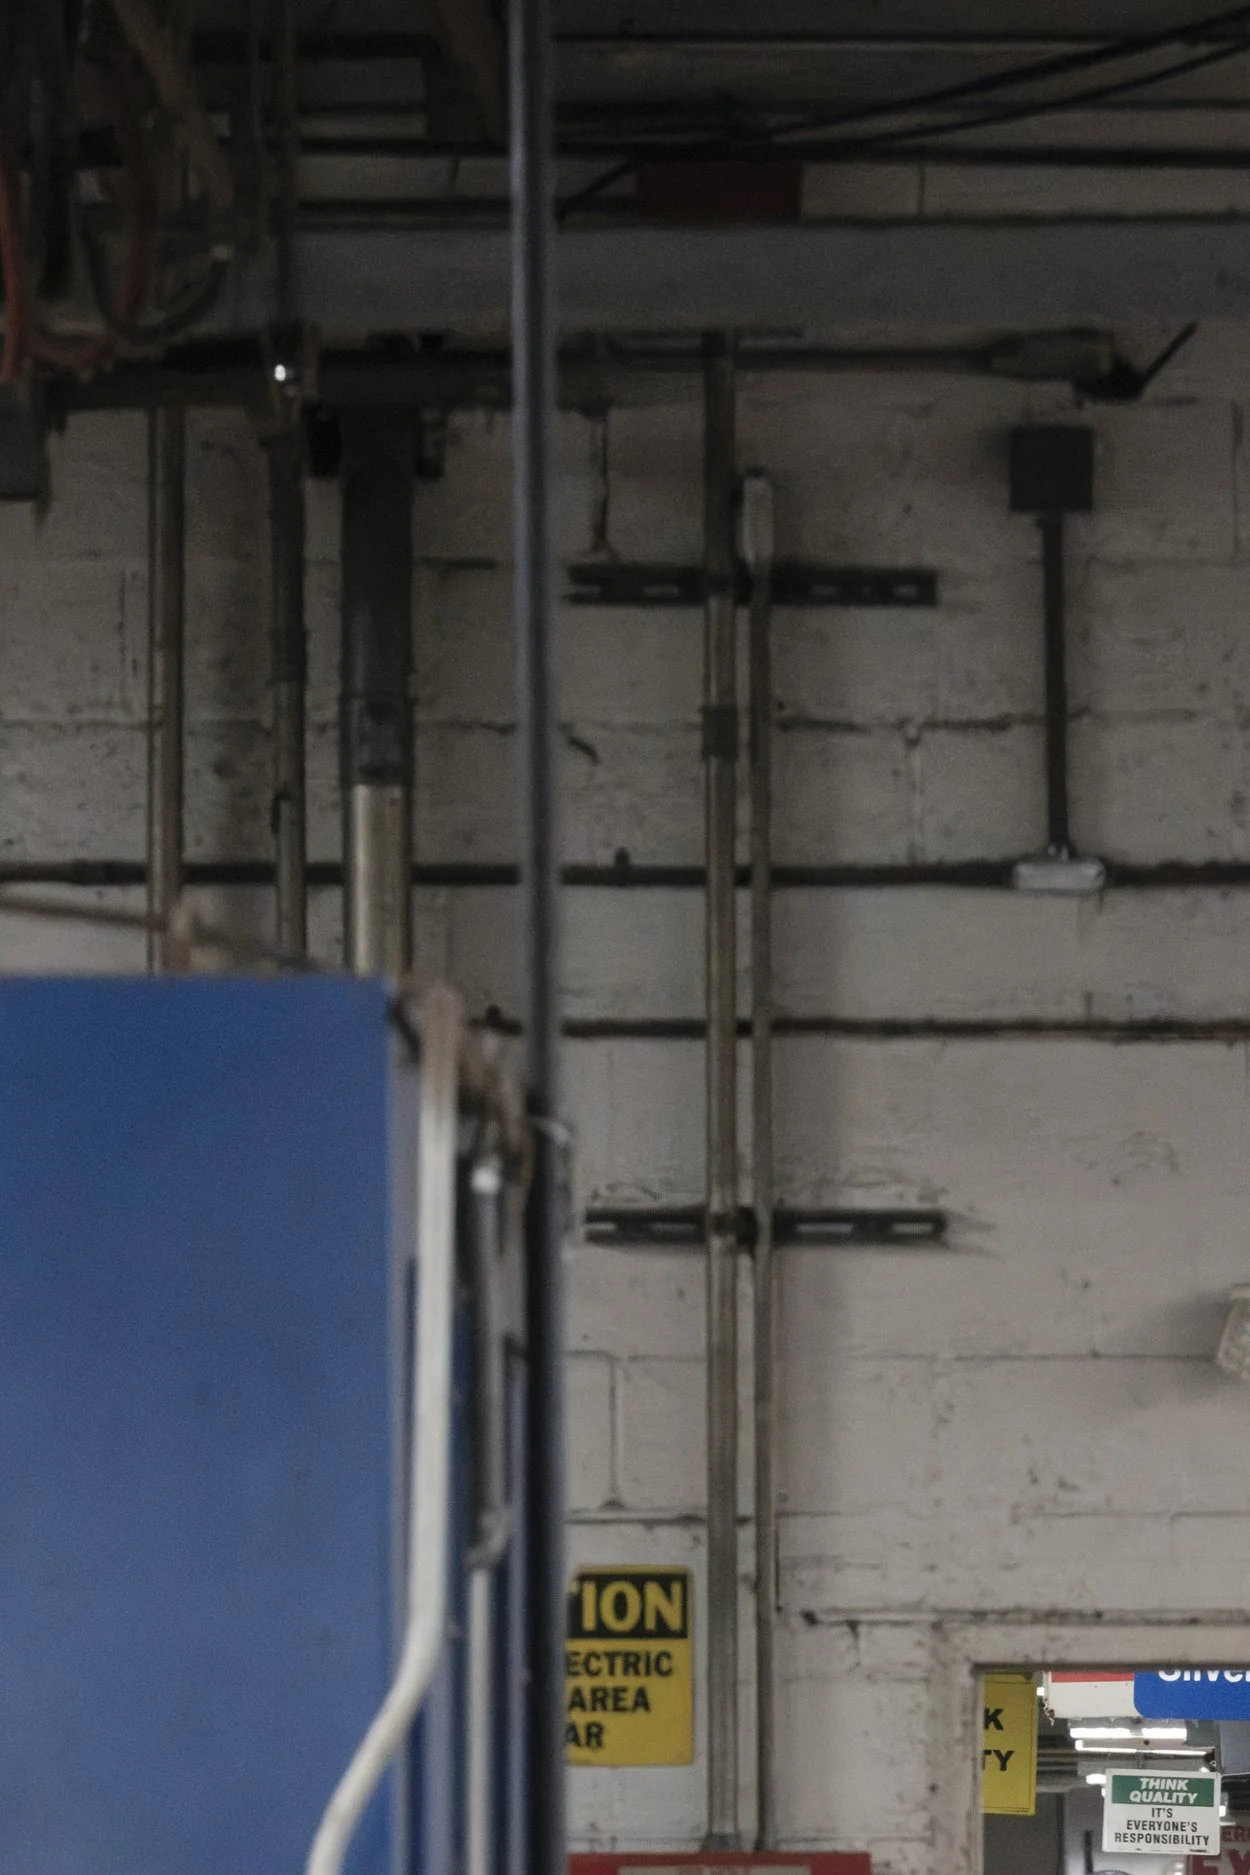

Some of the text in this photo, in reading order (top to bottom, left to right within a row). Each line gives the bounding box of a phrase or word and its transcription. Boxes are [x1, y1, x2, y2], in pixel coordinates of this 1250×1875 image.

[571, 1579, 685, 1633] ION
[568, 1685, 650, 1713] AREA
[1139, 1777, 1190, 1791] THINK
[1129, 1790, 1198, 1804] QUALITY
[1151, 1807, 1174, 1819] IT'S
[1126, 1819, 1198, 1833] EVERYONE'S
[1114, 1832, 1210, 1846] RESPONSIBILITY
